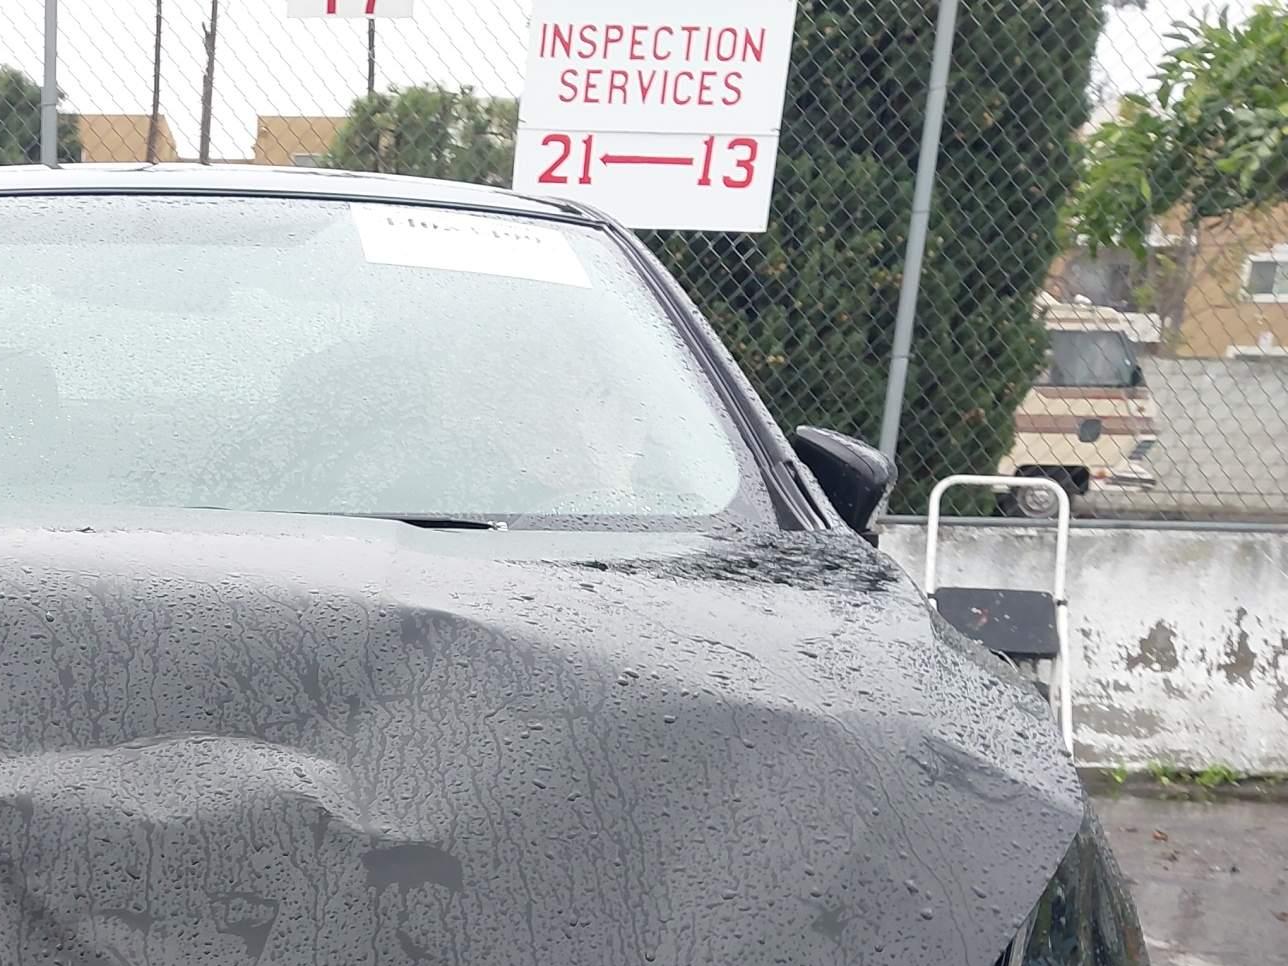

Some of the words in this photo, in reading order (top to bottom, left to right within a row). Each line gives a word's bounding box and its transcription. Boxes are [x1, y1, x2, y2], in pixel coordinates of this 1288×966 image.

[539, 23, 765, 63] INSPECTION
[558, 69, 742, 107] SERVICES
[537, 132, 595, 186] 21
[696, 134, 759, 190] 13
